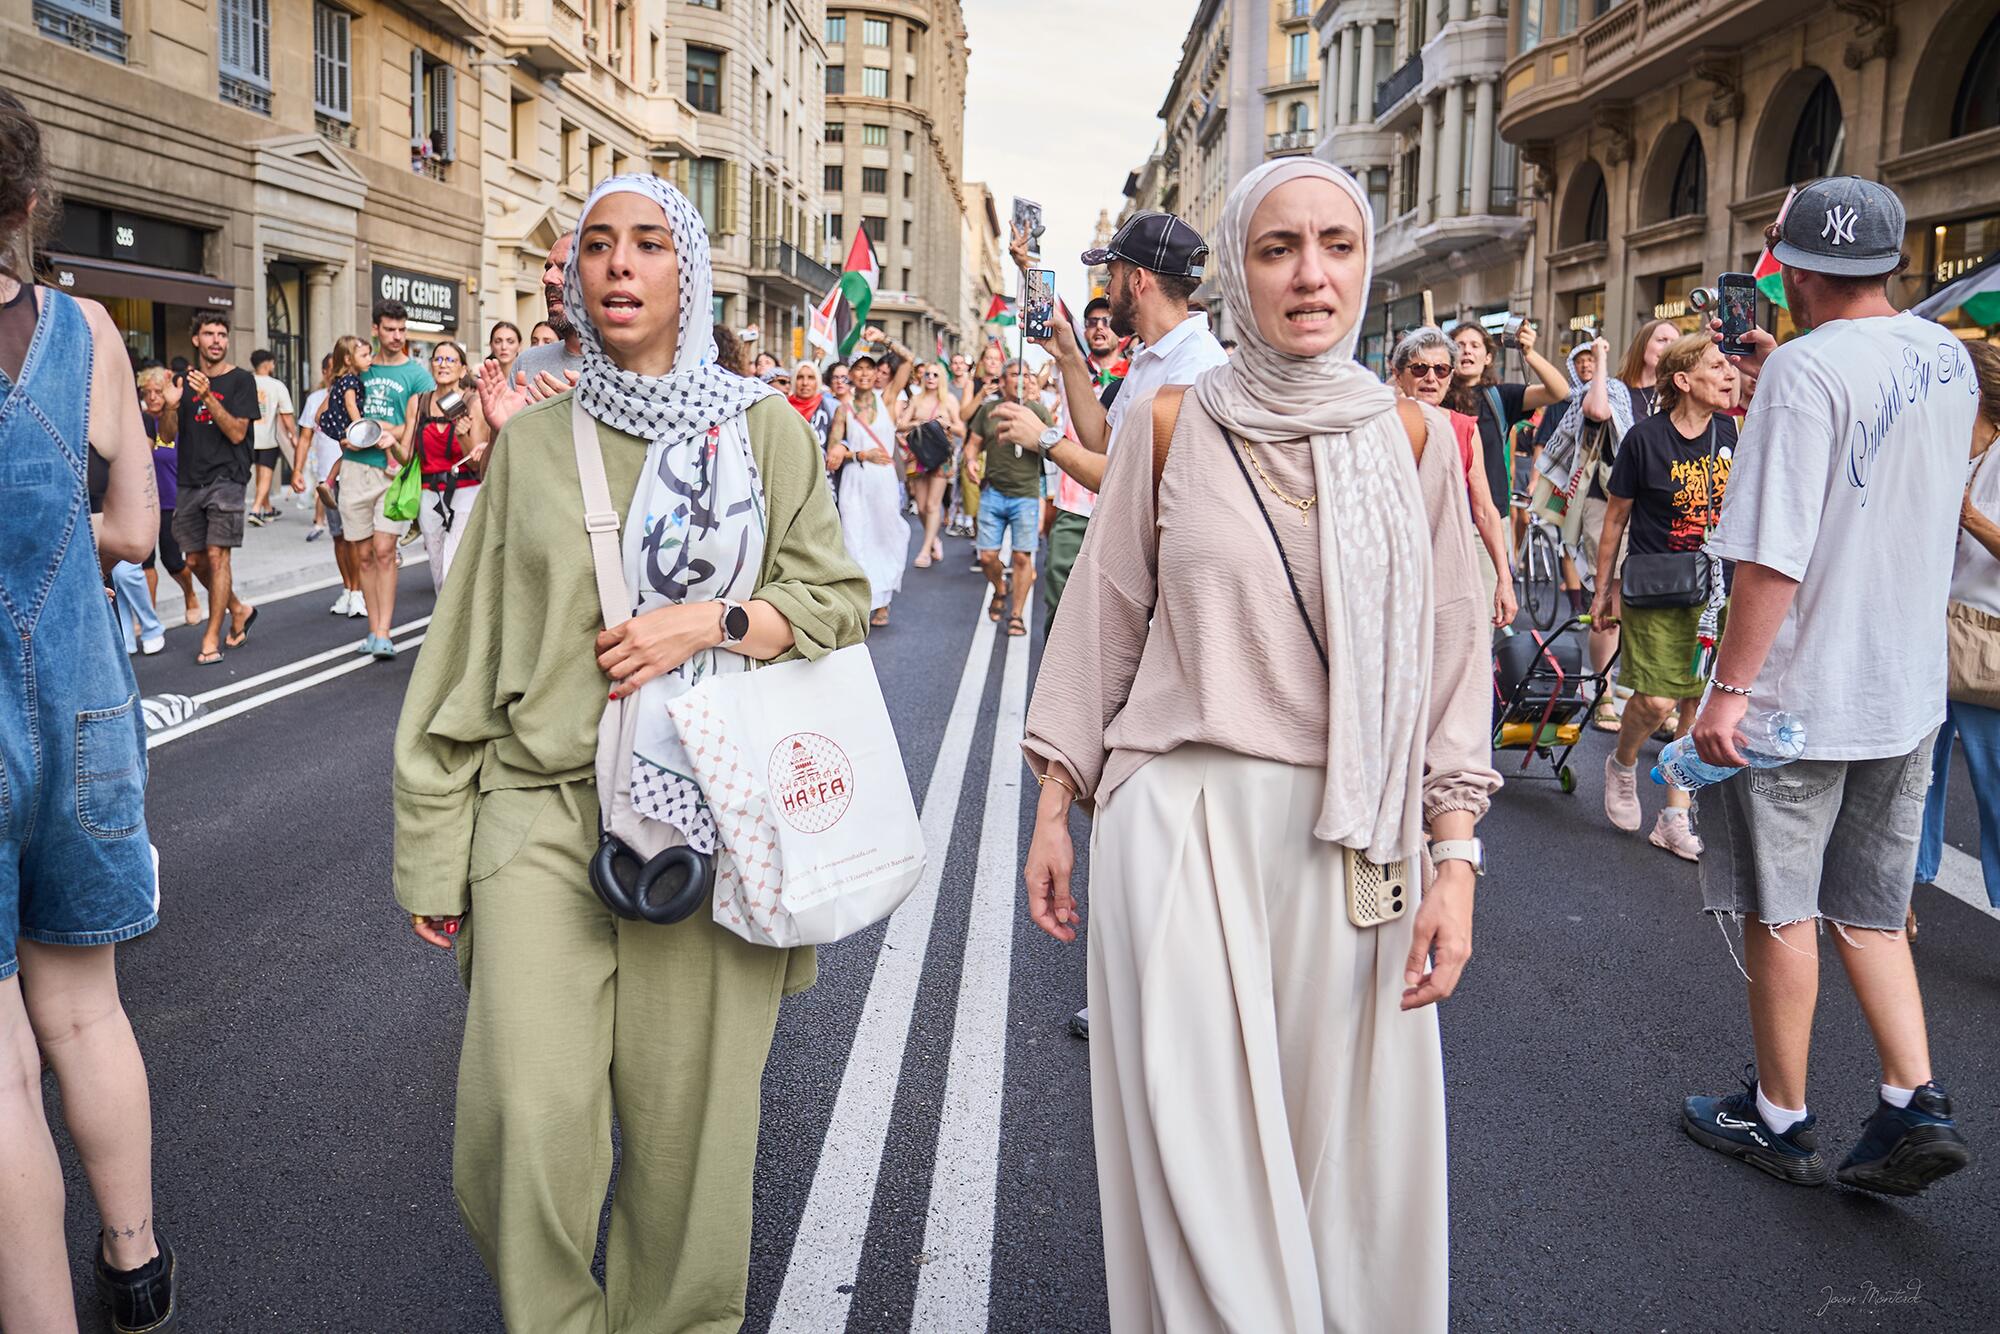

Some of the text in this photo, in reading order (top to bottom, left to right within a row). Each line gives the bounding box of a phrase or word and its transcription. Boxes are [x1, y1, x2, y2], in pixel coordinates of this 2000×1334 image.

[1821, 205, 1858, 245] NY
[381, 274, 451, 309] GIFT CENTER
[1847, 342, 1967, 508] Guided By The
